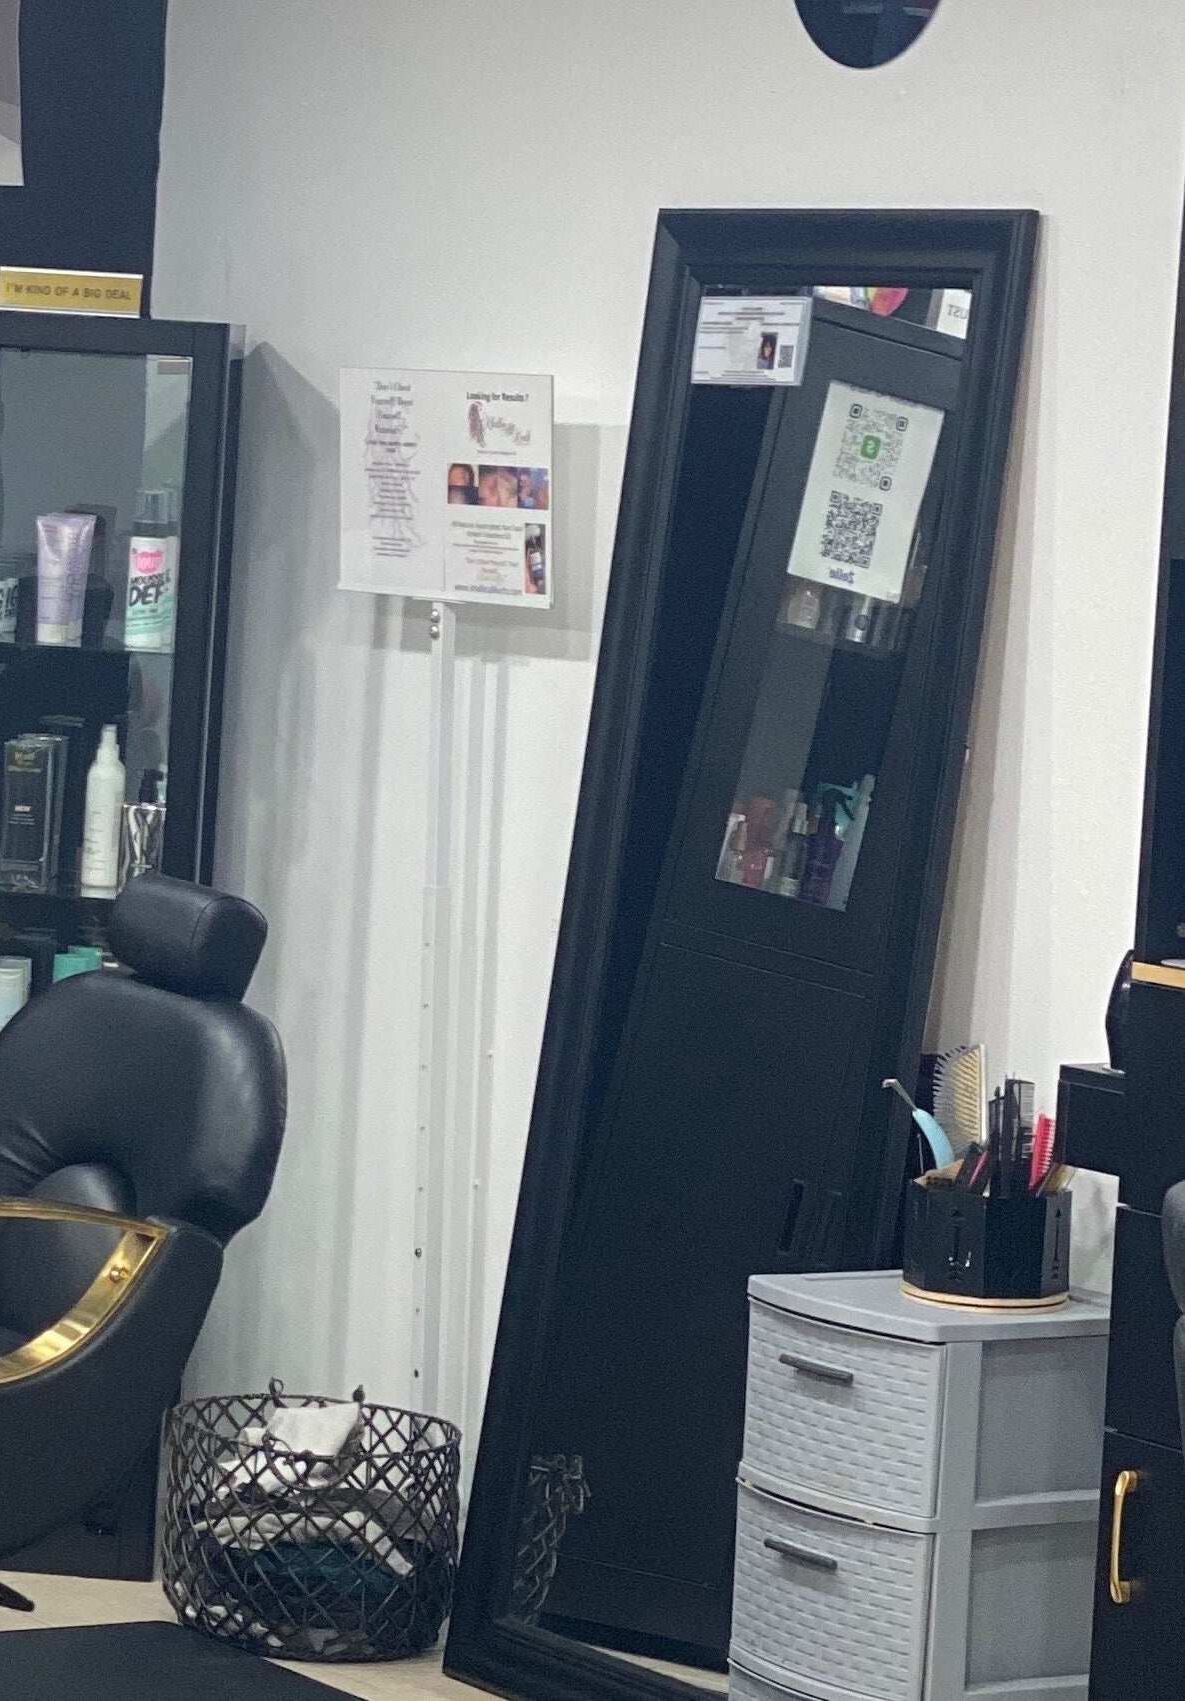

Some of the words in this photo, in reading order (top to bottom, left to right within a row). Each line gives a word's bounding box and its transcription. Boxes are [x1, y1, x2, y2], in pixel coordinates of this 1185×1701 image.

[25, 284, 51, 296] KIND
[54, 285, 69, 297] OF
[72, 287, 80, 297] A
[83, 287, 102, 299] BIG
[105, 289, 132, 300] DEAL
[467, 392, 490, 403] Looking
